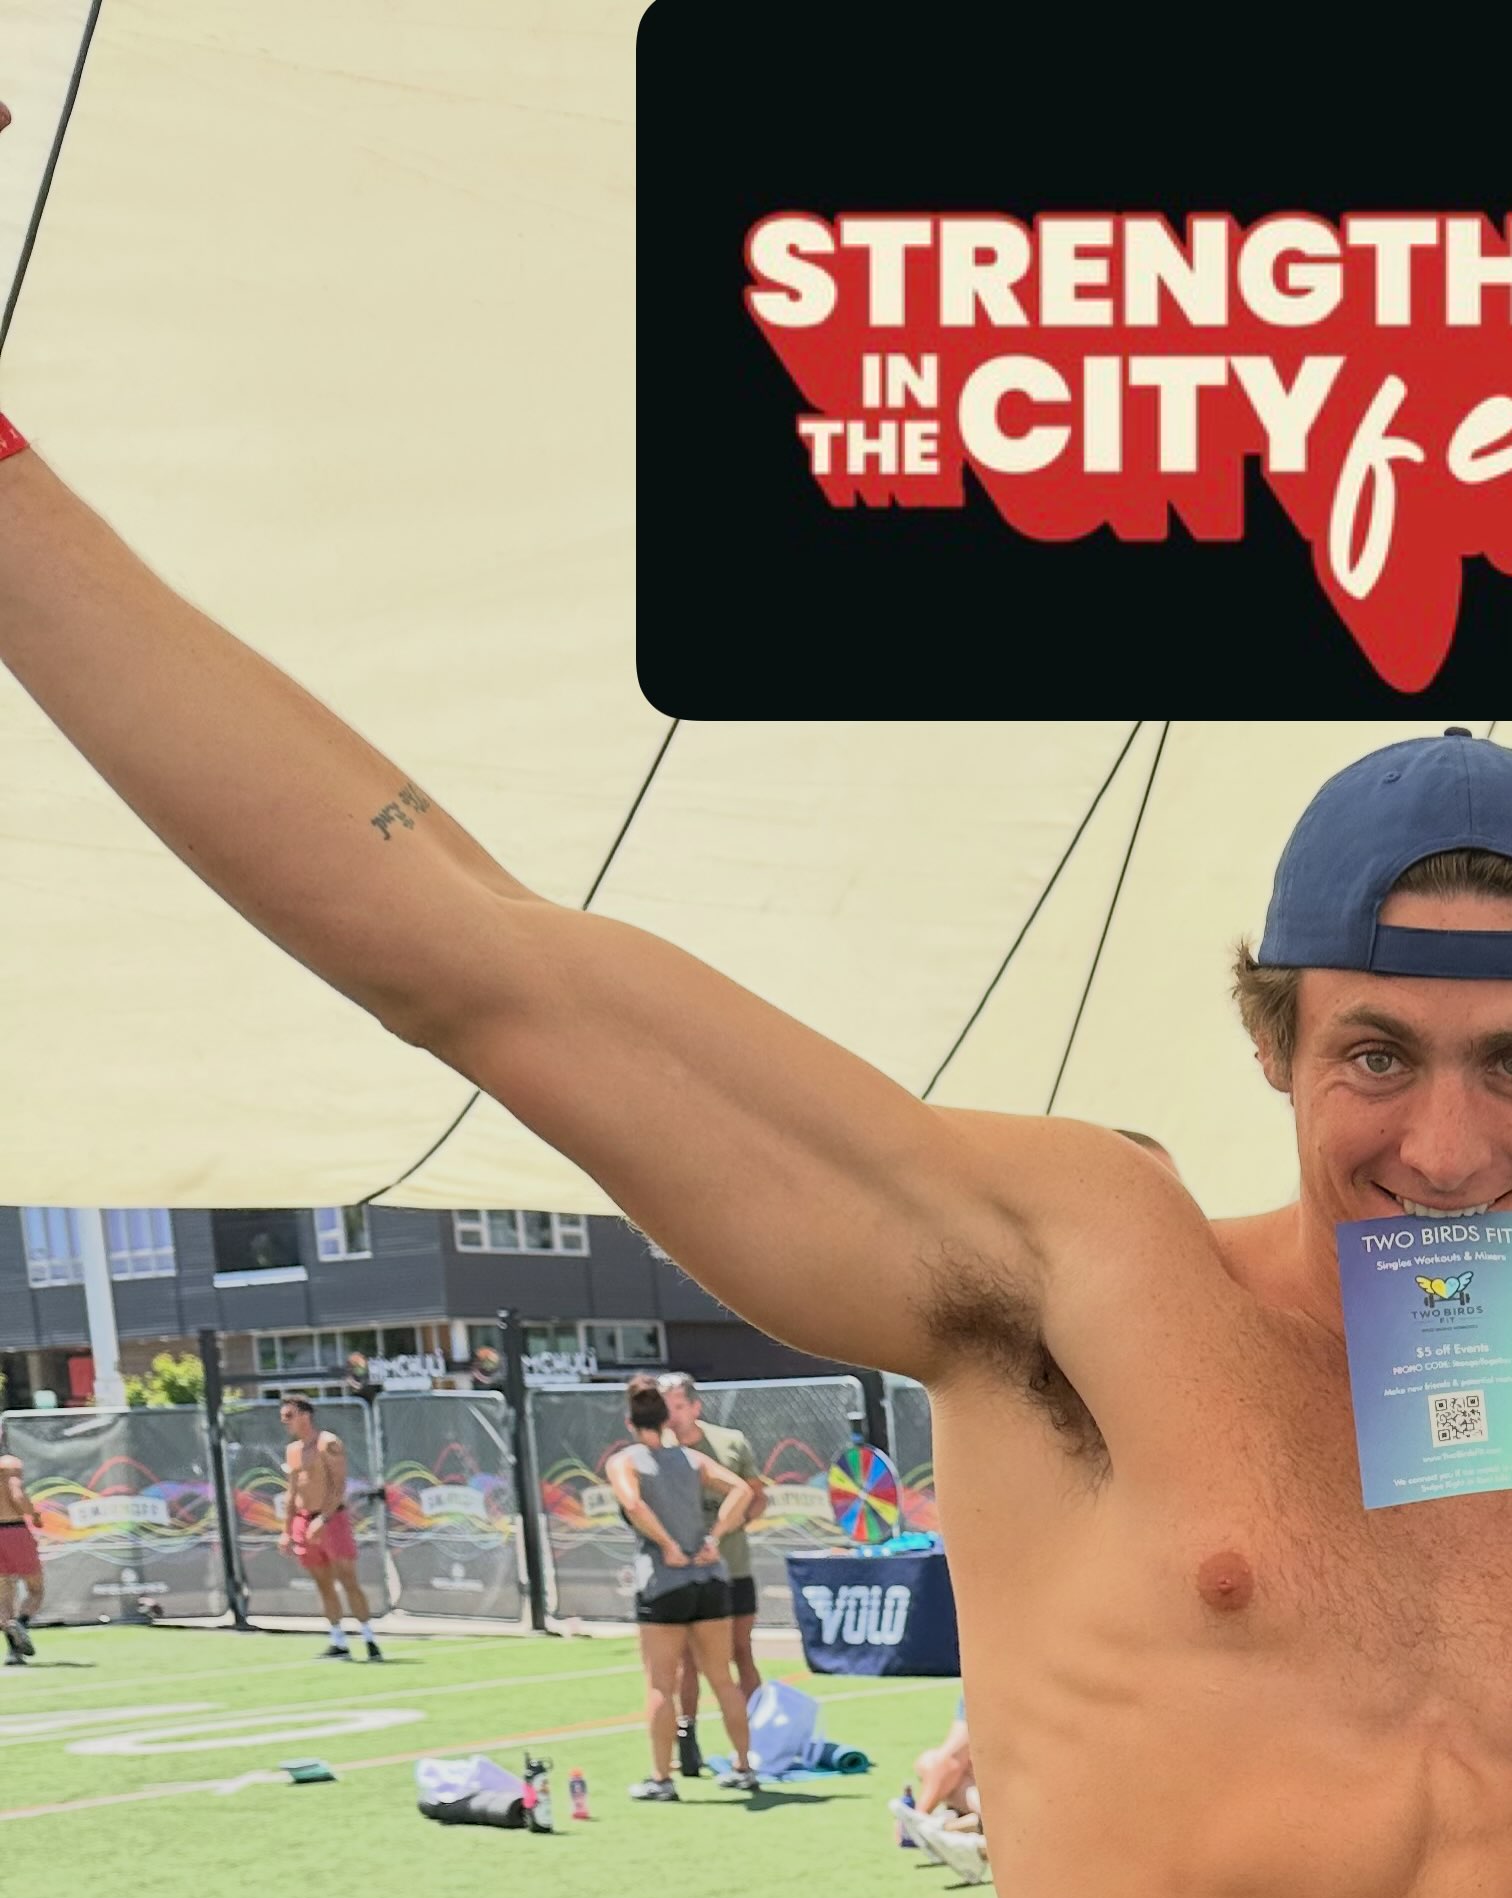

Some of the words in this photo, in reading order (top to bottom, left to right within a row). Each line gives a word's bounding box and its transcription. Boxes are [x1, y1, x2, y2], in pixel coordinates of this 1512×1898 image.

[1361, 1231, 1414, 1253] TWO
[1421, 1225, 1480, 1245] BIRDS
[1486, 1227, 1512, 1244] FIT
[1376, 1258, 1412, 1271] Singles
[1414, 1253, 1461, 1266] Workouts
[1463, 1251, 1472, 1261] &
[1411, 1308, 1441, 1319] TWO
[1444, 1305, 1484, 1317] BIRDS
[1416, 1347, 1432, 1358] $5
[1435, 1344, 1451, 1356] off
[1454, 1343, 1489, 1354] Events
[802, 1585, 911, 1645] VOLO
